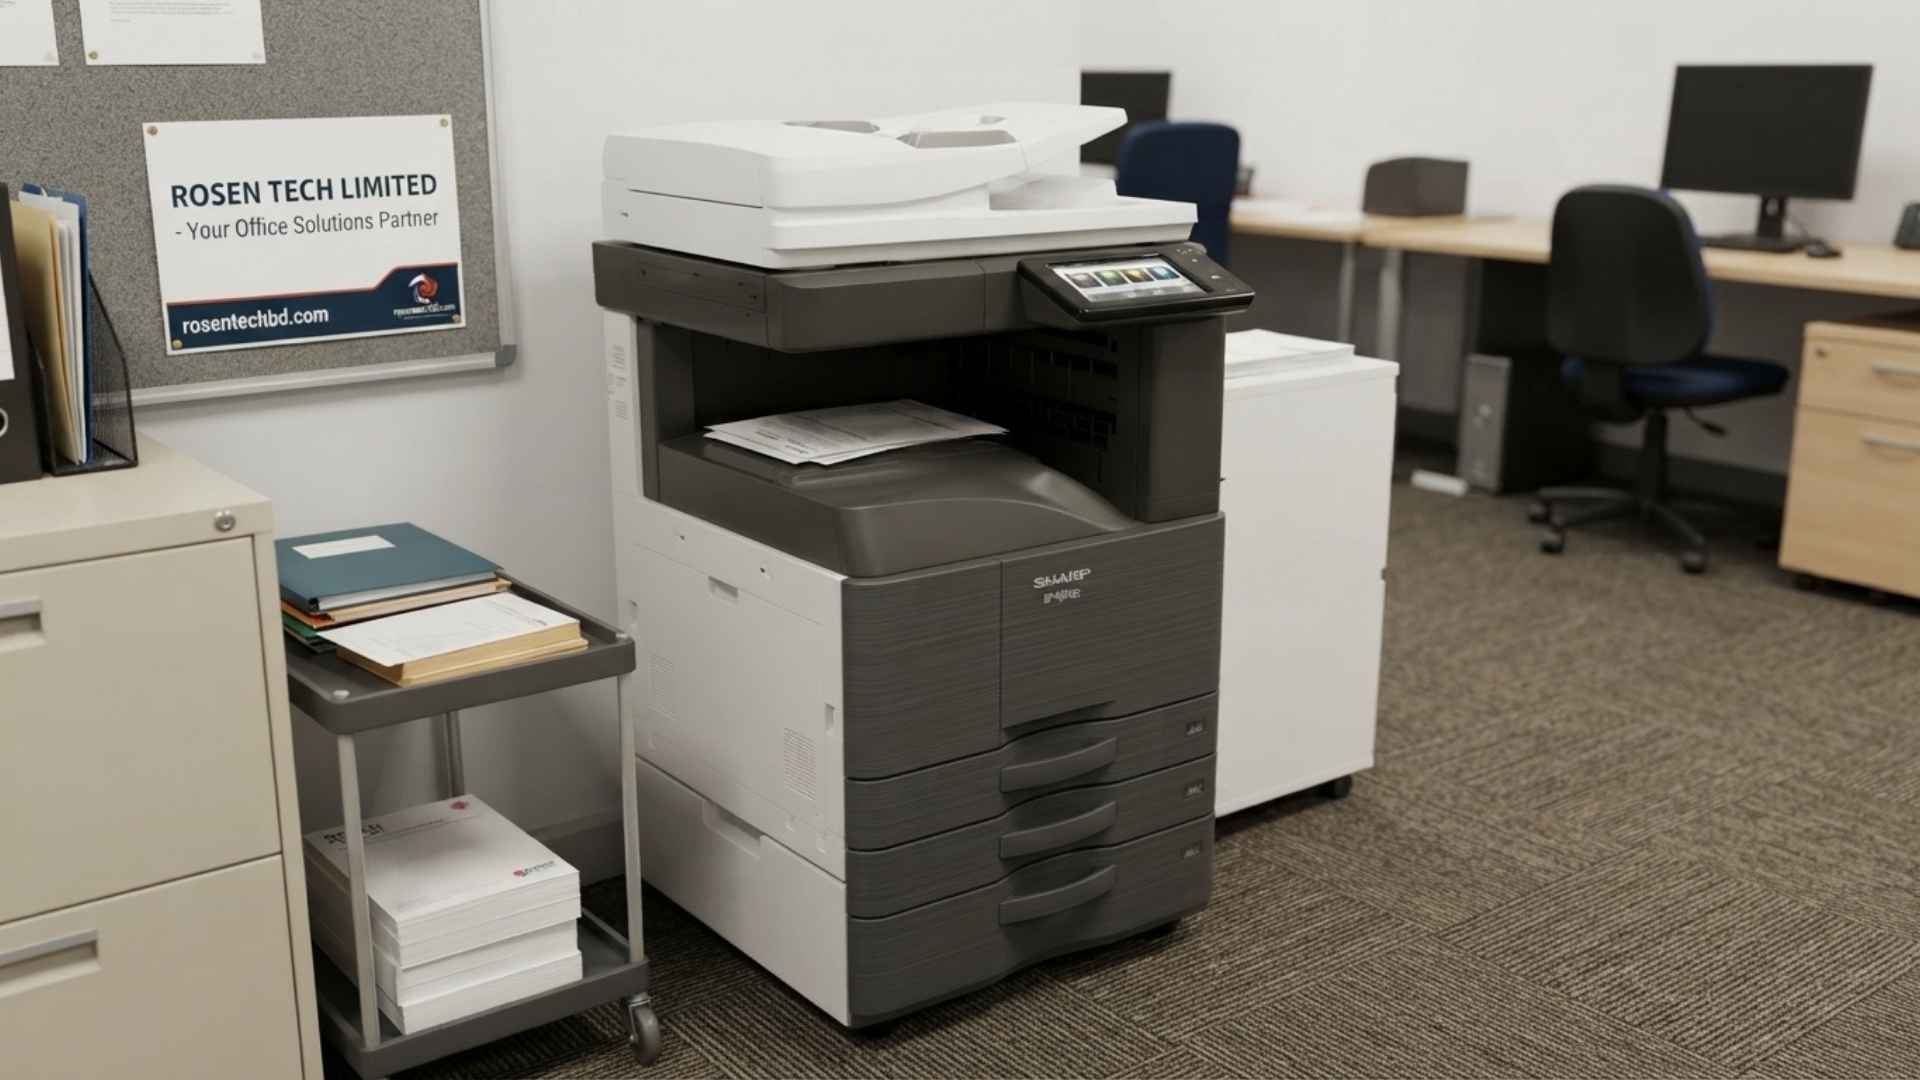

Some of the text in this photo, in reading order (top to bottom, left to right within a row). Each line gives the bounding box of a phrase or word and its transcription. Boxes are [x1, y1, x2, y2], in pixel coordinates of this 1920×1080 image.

[171, 173, 437, 208] ROSEN TECH LIMITED
[186, 221, 230, 240] Your
[235, 217, 288, 238] Office
[293, 212, 374, 234] Solutions
[379, 210, 438, 228] Partner
